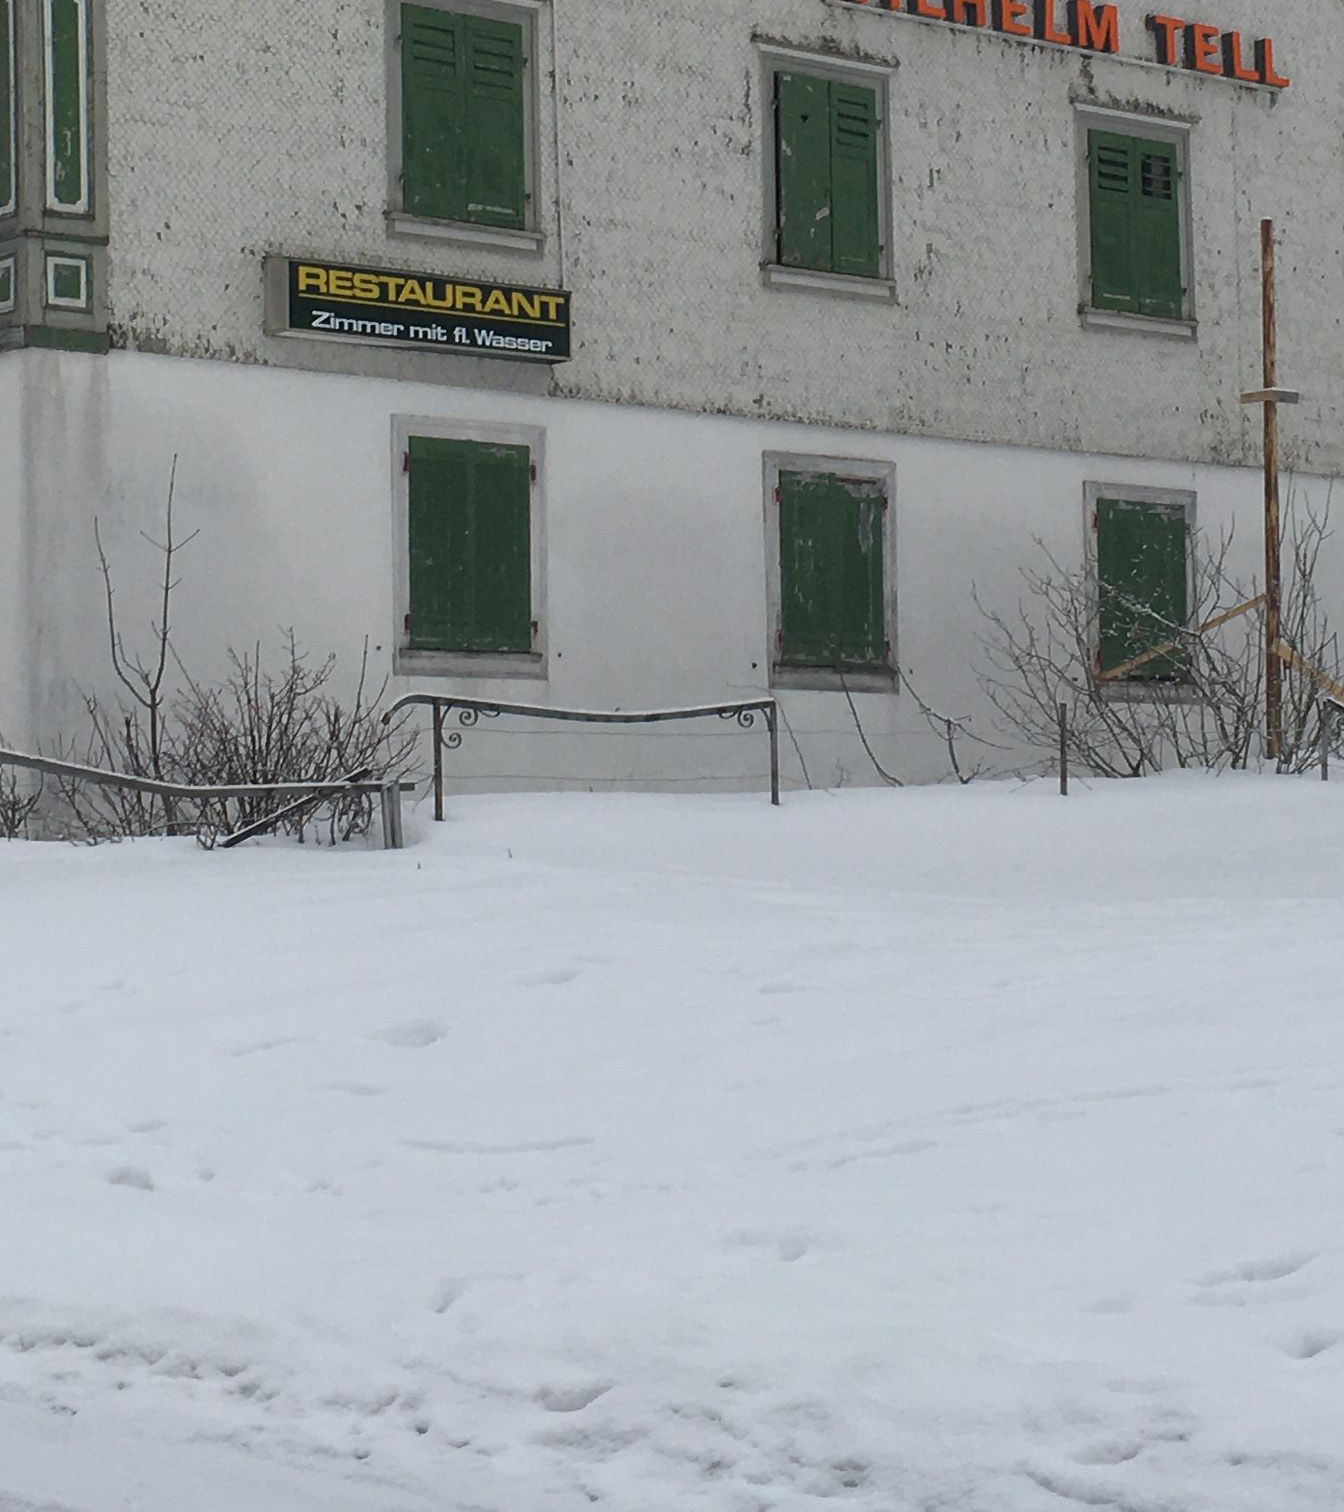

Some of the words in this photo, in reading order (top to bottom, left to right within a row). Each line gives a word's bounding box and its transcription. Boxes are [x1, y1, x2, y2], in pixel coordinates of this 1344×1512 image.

[1147, 14, 1291, 87] TELL
[297, 265, 565, 321] RESTAURANT
[311, 310, 405, 337] Zimmer
[409, 324, 448, 343] mit
[474, 329, 553, 353] Wasser
